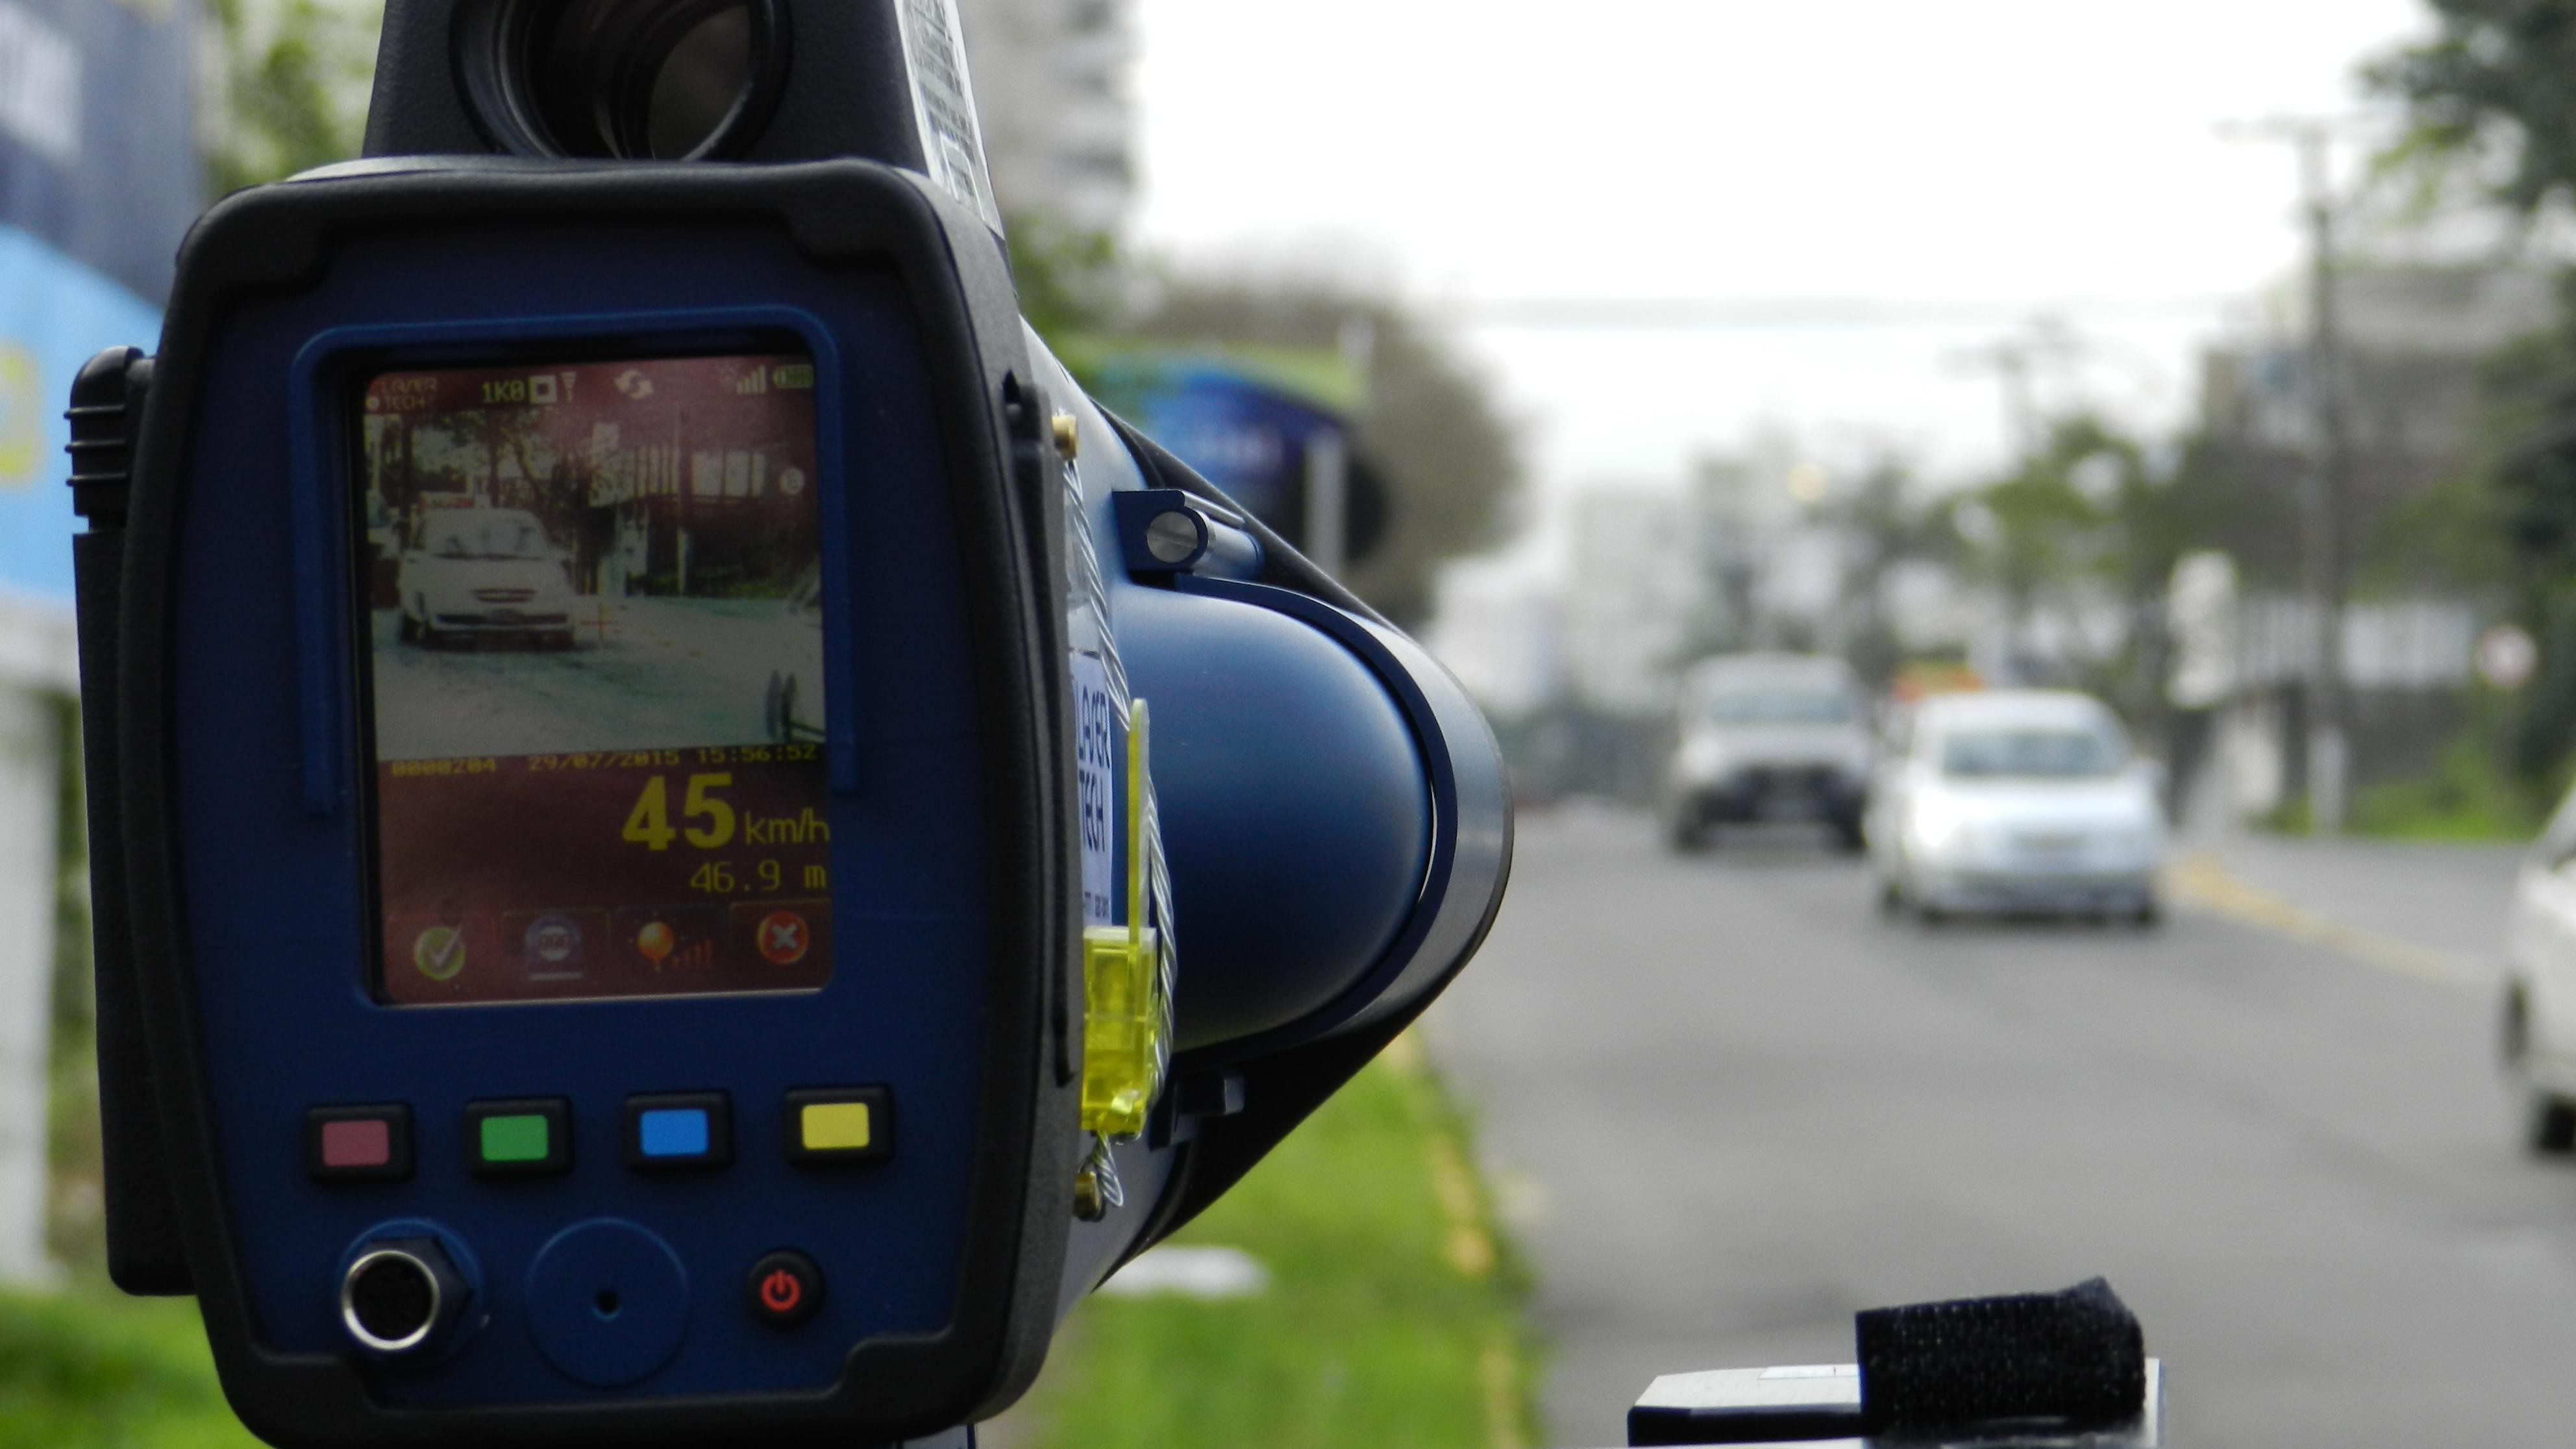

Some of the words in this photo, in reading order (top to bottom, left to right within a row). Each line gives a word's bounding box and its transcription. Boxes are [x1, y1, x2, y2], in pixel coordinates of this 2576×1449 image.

[528, 750, 680, 771] 29/07/2015
[697, 745, 816, 765] 15:56:52
[621, 773, 736, 851] 45
[744, 808, 831, 845] km/h
[1079, 769, 1106, 853] TECH
[689, 858, 781, 893] 46.9
[803, 865, 828, 889] m
